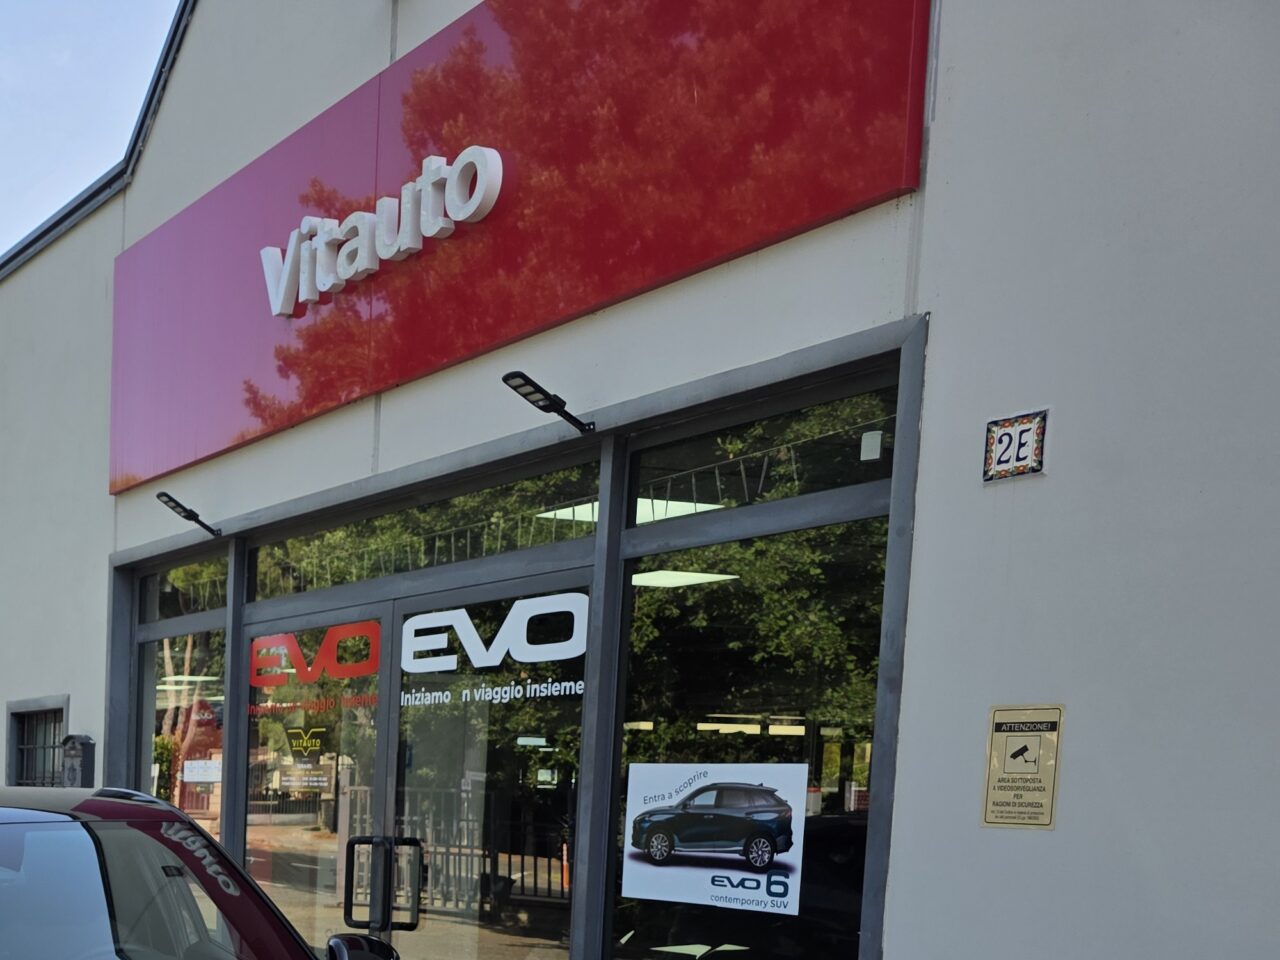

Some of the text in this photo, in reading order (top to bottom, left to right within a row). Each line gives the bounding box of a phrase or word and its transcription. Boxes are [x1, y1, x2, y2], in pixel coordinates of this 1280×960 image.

[260, 145, 503, 317] Vitauto
[997, 428, 1032, 465] 2E
[400, 592, 590, 673] EVO
[249, 620, 382, 687] EVO
[400, 687, 451, 706] Iniziamo
[473, 681, 523, 703] viaggio
[526, 678, 585, 698] insieme
[292, 738, 320, 747] VITAUTO
[1001, 723, 1051, 732] ATTENZIONE!
[643, 792, 666, 805] Entra
[675, 769, 709, 796] scoprire
[711, 871, 790, 898] EVO 6
[710, 894, 789, 909] contemporary SUV
